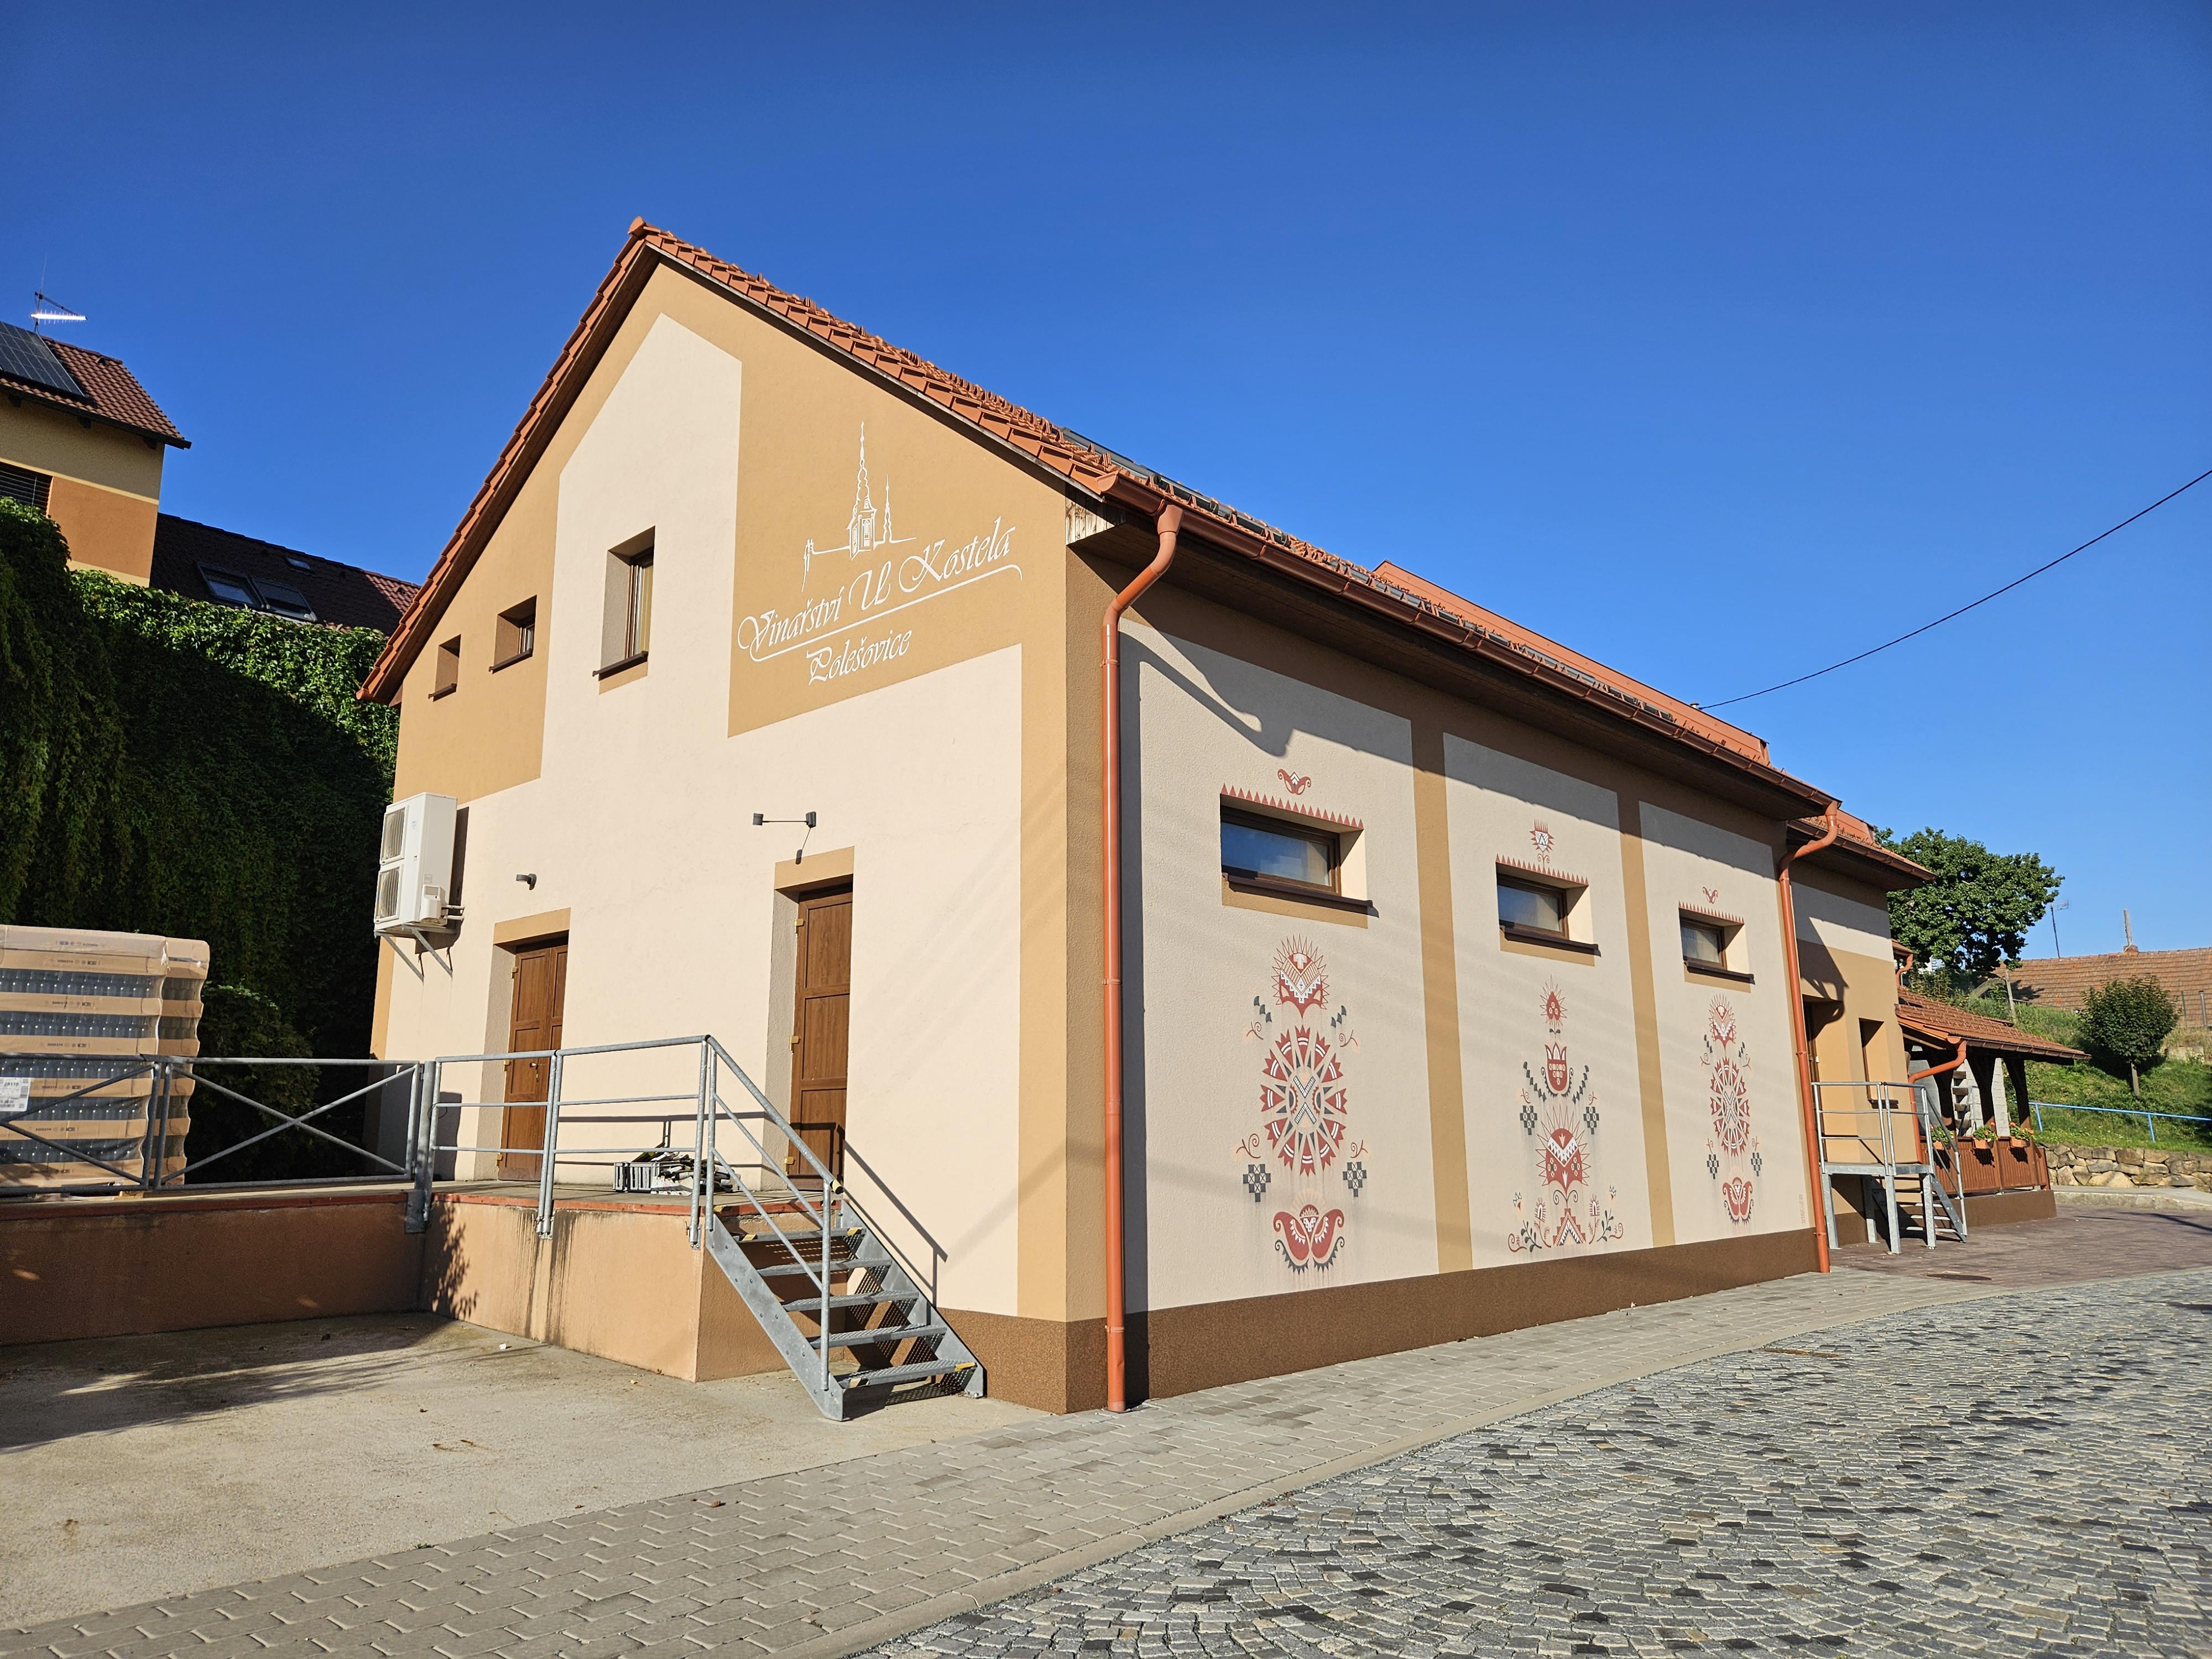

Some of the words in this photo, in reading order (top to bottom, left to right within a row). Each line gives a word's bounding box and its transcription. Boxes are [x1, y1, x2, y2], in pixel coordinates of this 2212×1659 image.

[738, 585, 844, 653] Vinařství
[848, 561, 891, 611] U
[806, 630, 911, 685] Polešovice
